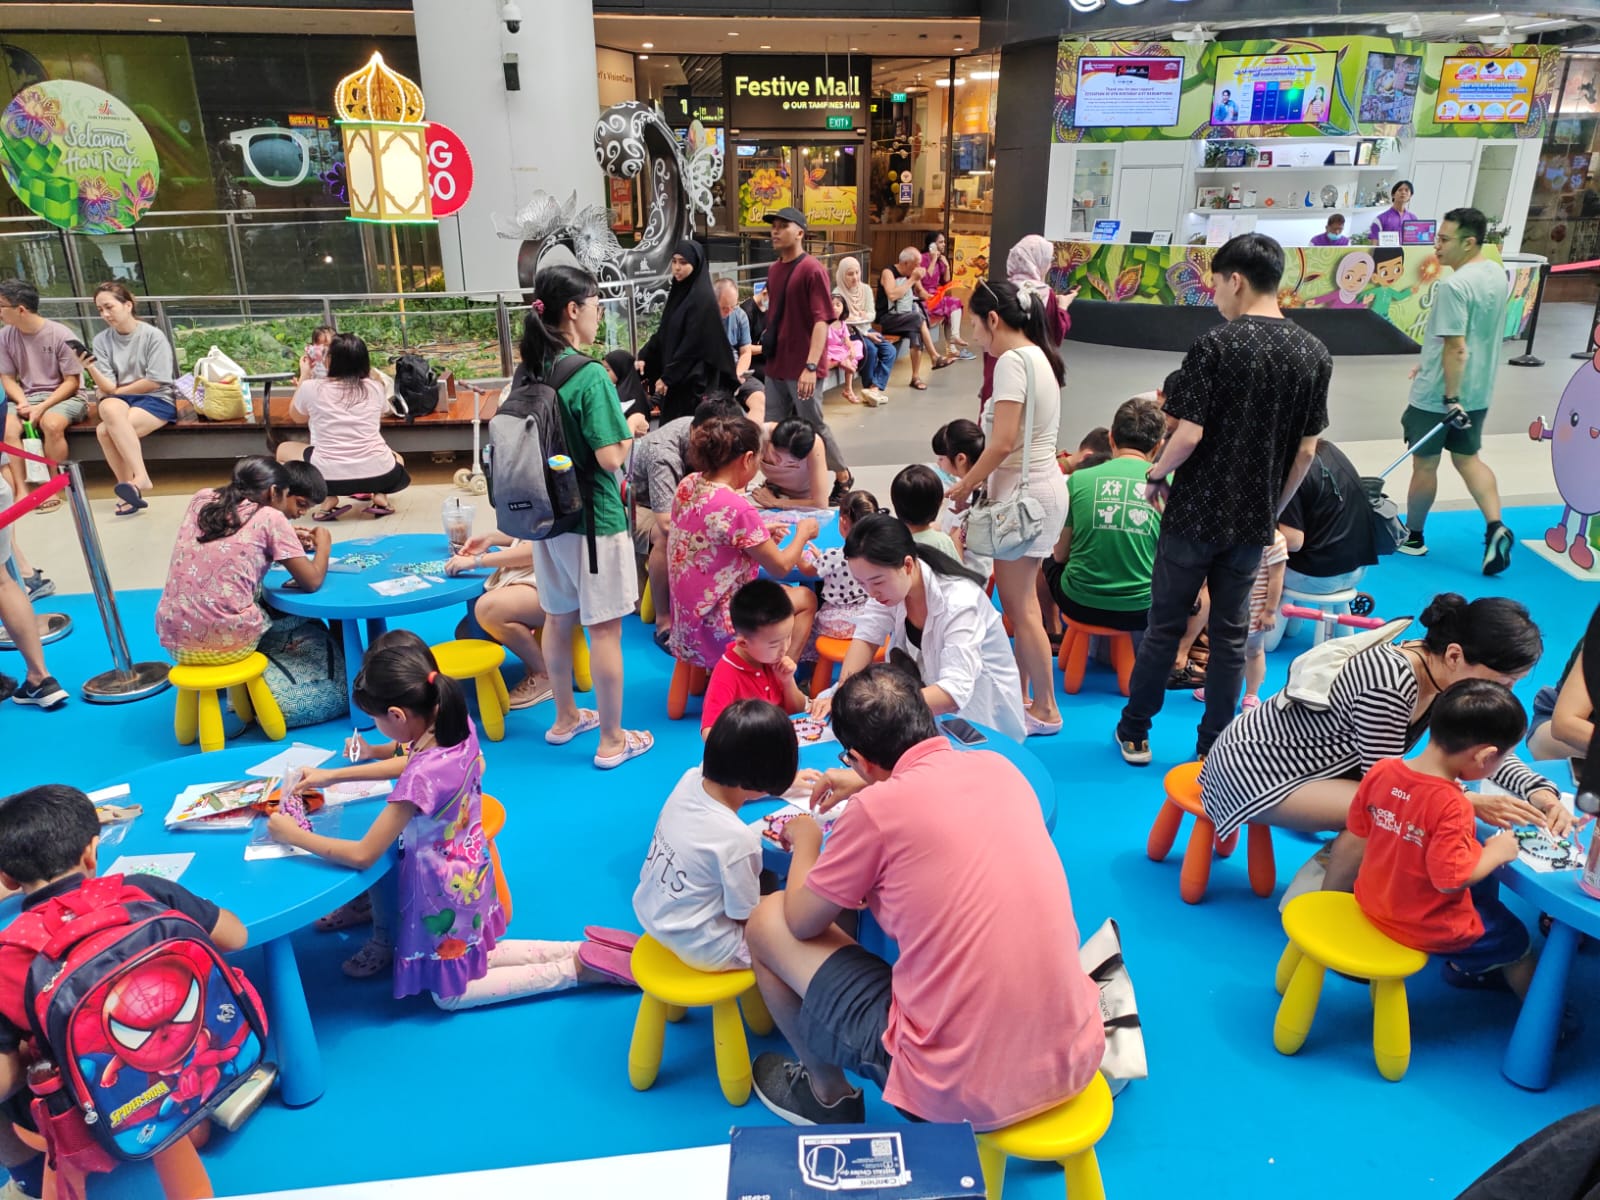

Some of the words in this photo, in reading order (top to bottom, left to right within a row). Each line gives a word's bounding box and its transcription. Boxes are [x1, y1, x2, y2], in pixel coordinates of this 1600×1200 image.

[735, 76, 809, 96] Festive
[815, 76, 860, 96] Mall
[680, 99, 688, 115] 1
[791, 101, 807, 109] OUR
[844, 101, 860, 110] HUB
[828, 118, 845, 128] EXIT
[64, 122, 135, 155] Selamat
[63, 150, 99, 175] Hari
[101, 149, 140, 178] Raya
[426, 140, 453, 169] G
